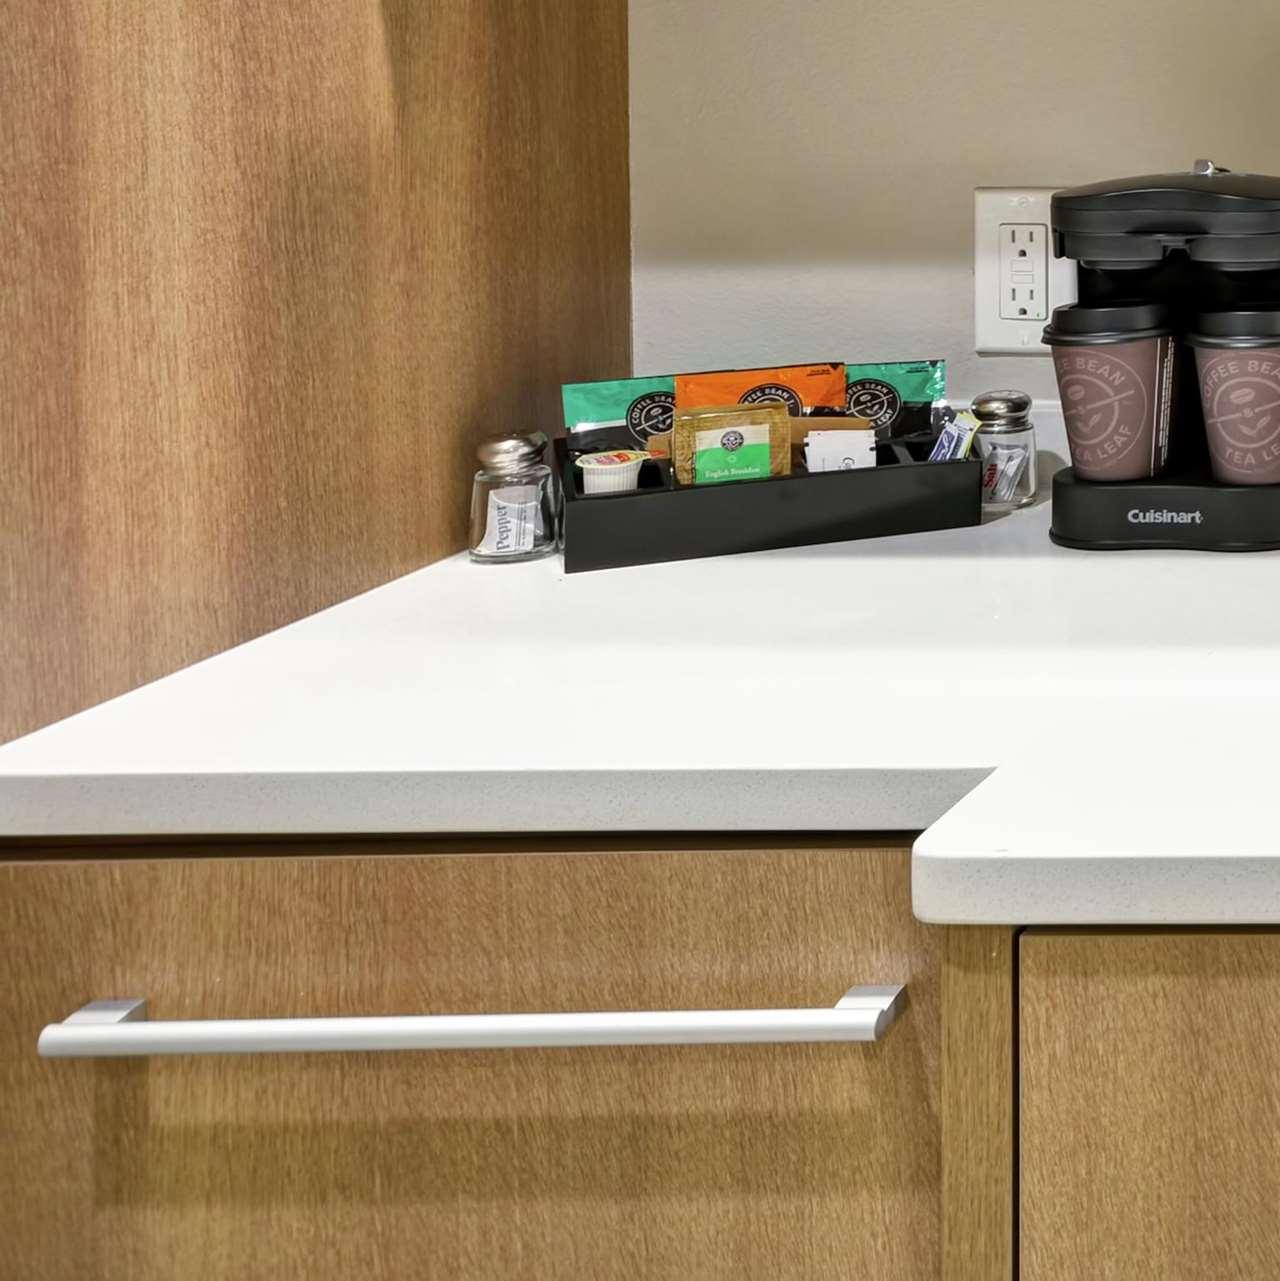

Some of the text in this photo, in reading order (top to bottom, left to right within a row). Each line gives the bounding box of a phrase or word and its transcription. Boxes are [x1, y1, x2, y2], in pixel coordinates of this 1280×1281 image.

[1076, 358, 1126, 386] BEAN
[654, 395, 676, 404] BEA
[1097, 423, 1131, 459] LEAF
[1225, 446, 1257, 465] TEA
[496, 504, 511, 551] Pepper
[1127, 509, 1203, 524] Cuisinart
